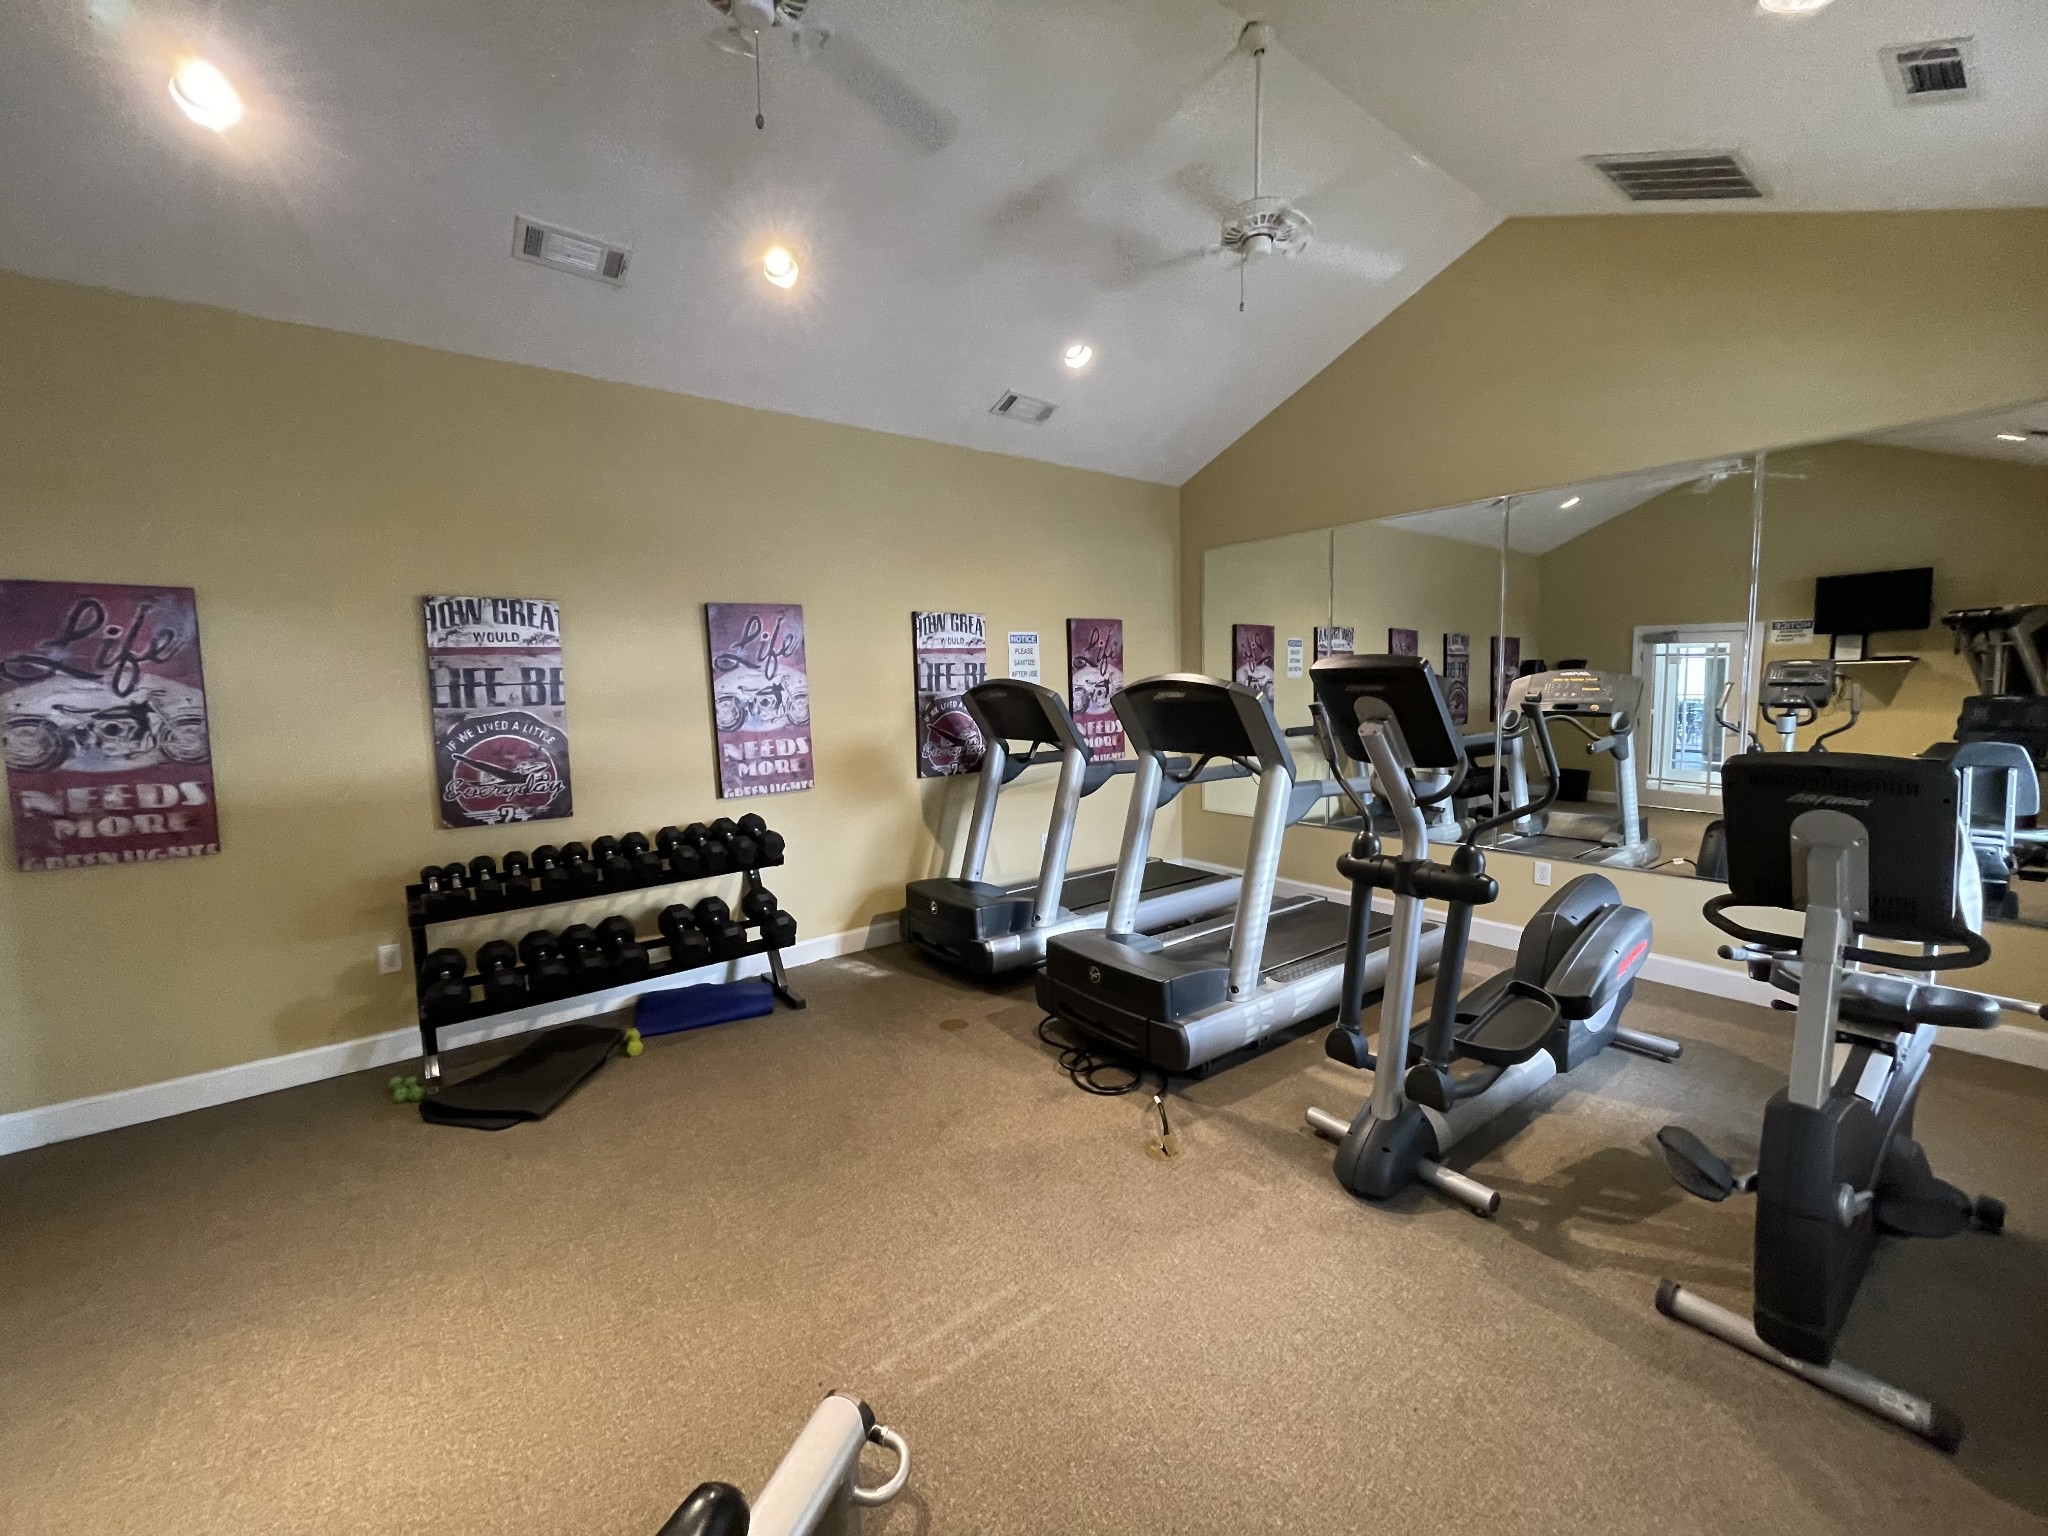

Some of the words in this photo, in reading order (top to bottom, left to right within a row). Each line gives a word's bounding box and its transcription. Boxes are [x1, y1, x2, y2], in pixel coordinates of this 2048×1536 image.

[491, 598, 559, 632] GREA
[951, 613, 985, 637] GREA
[0, 599, 178, 698] Life
[473, 632, 520, 643] WOULD
[713, 614, 800, 680] Life
[941, 637, 965, 645] WOULD
[1011, 635, 1037, 643] NOTICE
[1073, 627, 1117, 676] Life
[429, 667, 505, 708] LIFE
[445, 741, 457, 751] IF
[458, 729, 475, 743] WE
[476, 721, 508, 734] LIVED
[512, 721, 520, 730] A
[523, 723, 556, 745] LITTLE
[723, 736, 810, 762] NEEDS
[738, 759, 802, 777] MORE
[20, 781, 207, 817] NEEDS
[443, 773, 566, 801] Everyday
[55, 813, 196, 840] MORE
